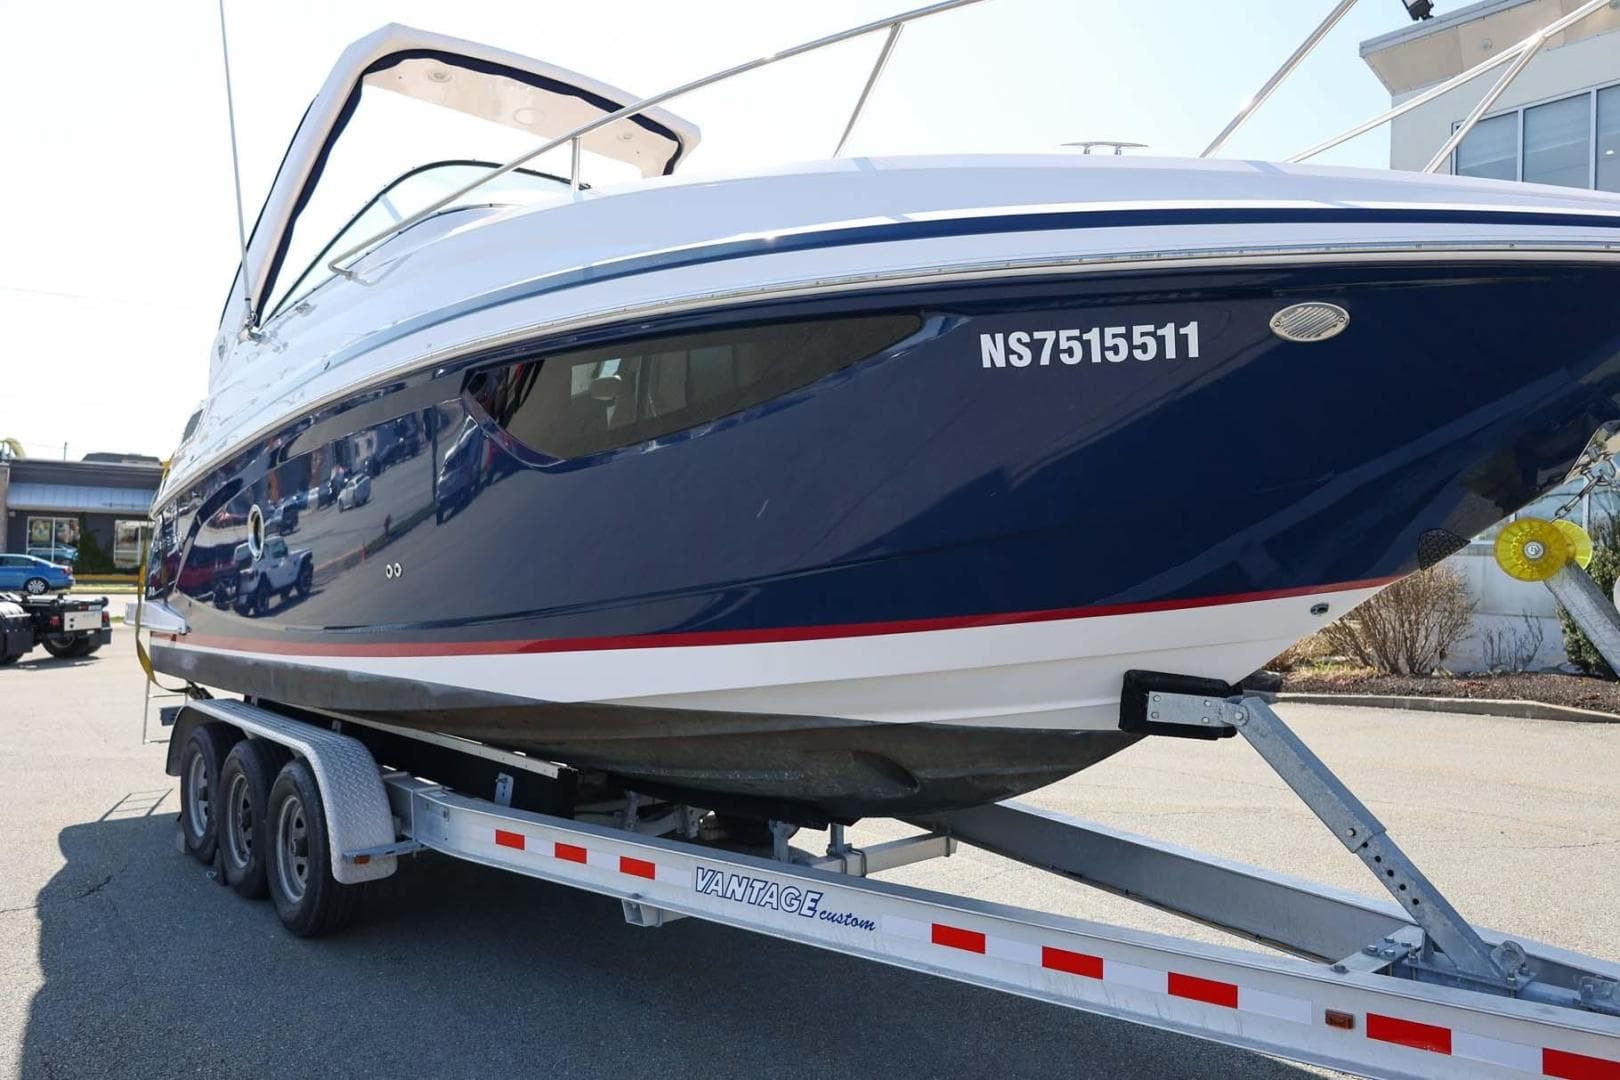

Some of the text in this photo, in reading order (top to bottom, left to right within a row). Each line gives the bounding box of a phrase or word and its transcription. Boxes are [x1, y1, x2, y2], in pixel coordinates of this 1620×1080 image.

[980, 321, 1199, 368] NS7515511
[696, 867, 876, 931] VANTAGE custom
